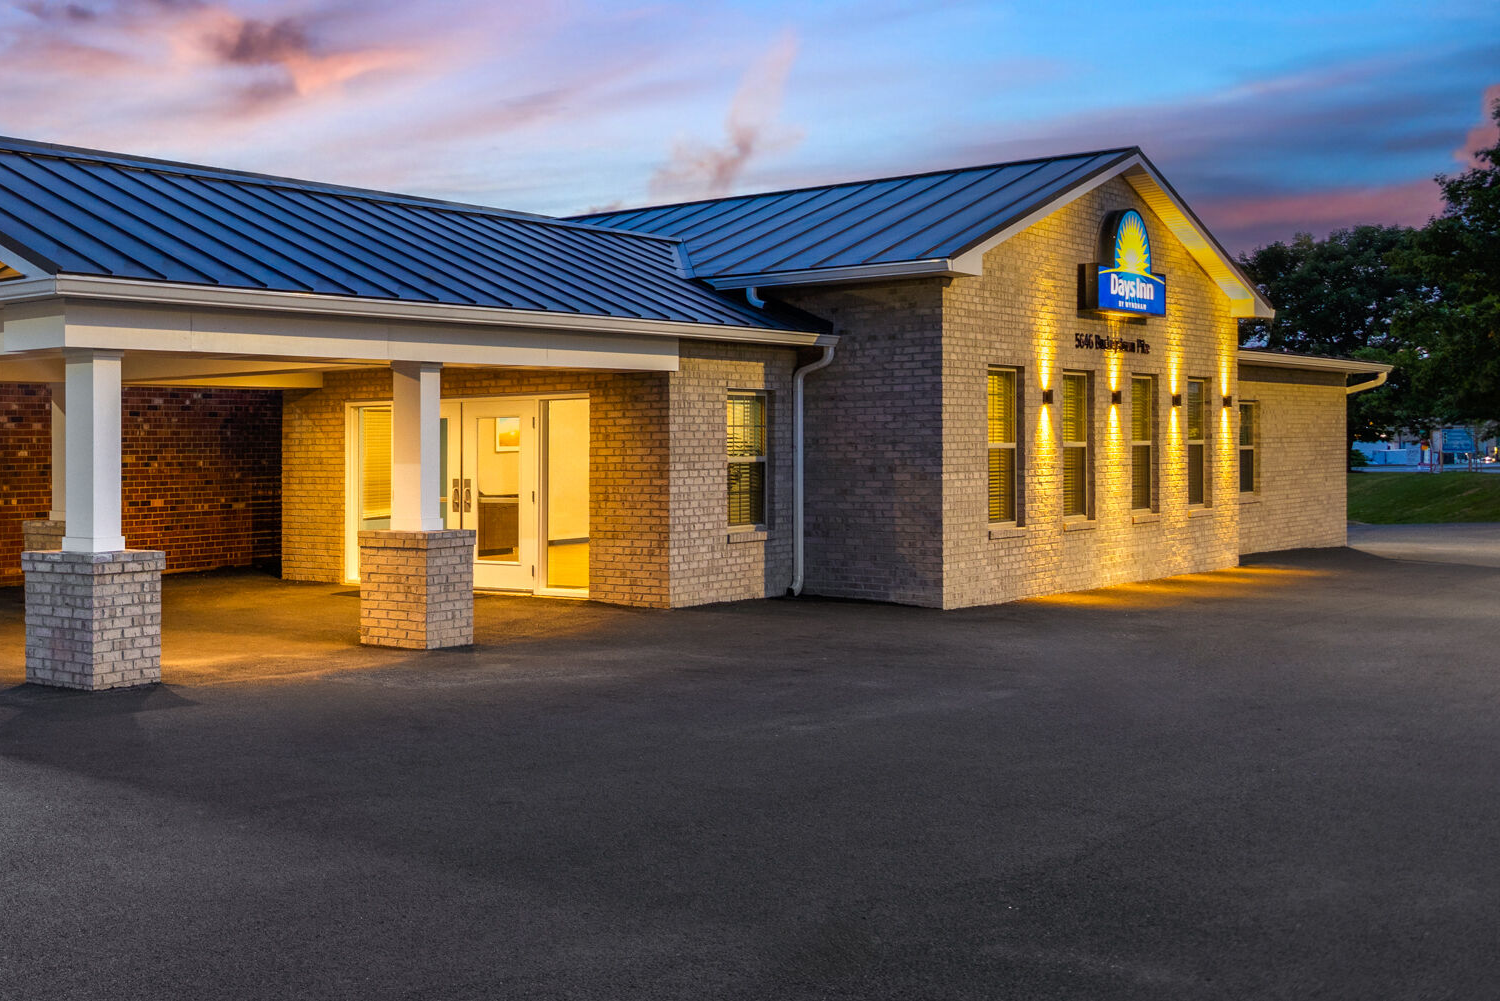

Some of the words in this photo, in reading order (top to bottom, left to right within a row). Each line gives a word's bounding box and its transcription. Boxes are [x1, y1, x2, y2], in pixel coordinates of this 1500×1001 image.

[1110, 273, 1136, 300] Days
[1136, 278, 1154, 300] Inn
[1075, 333, 1094, 349] 5646
